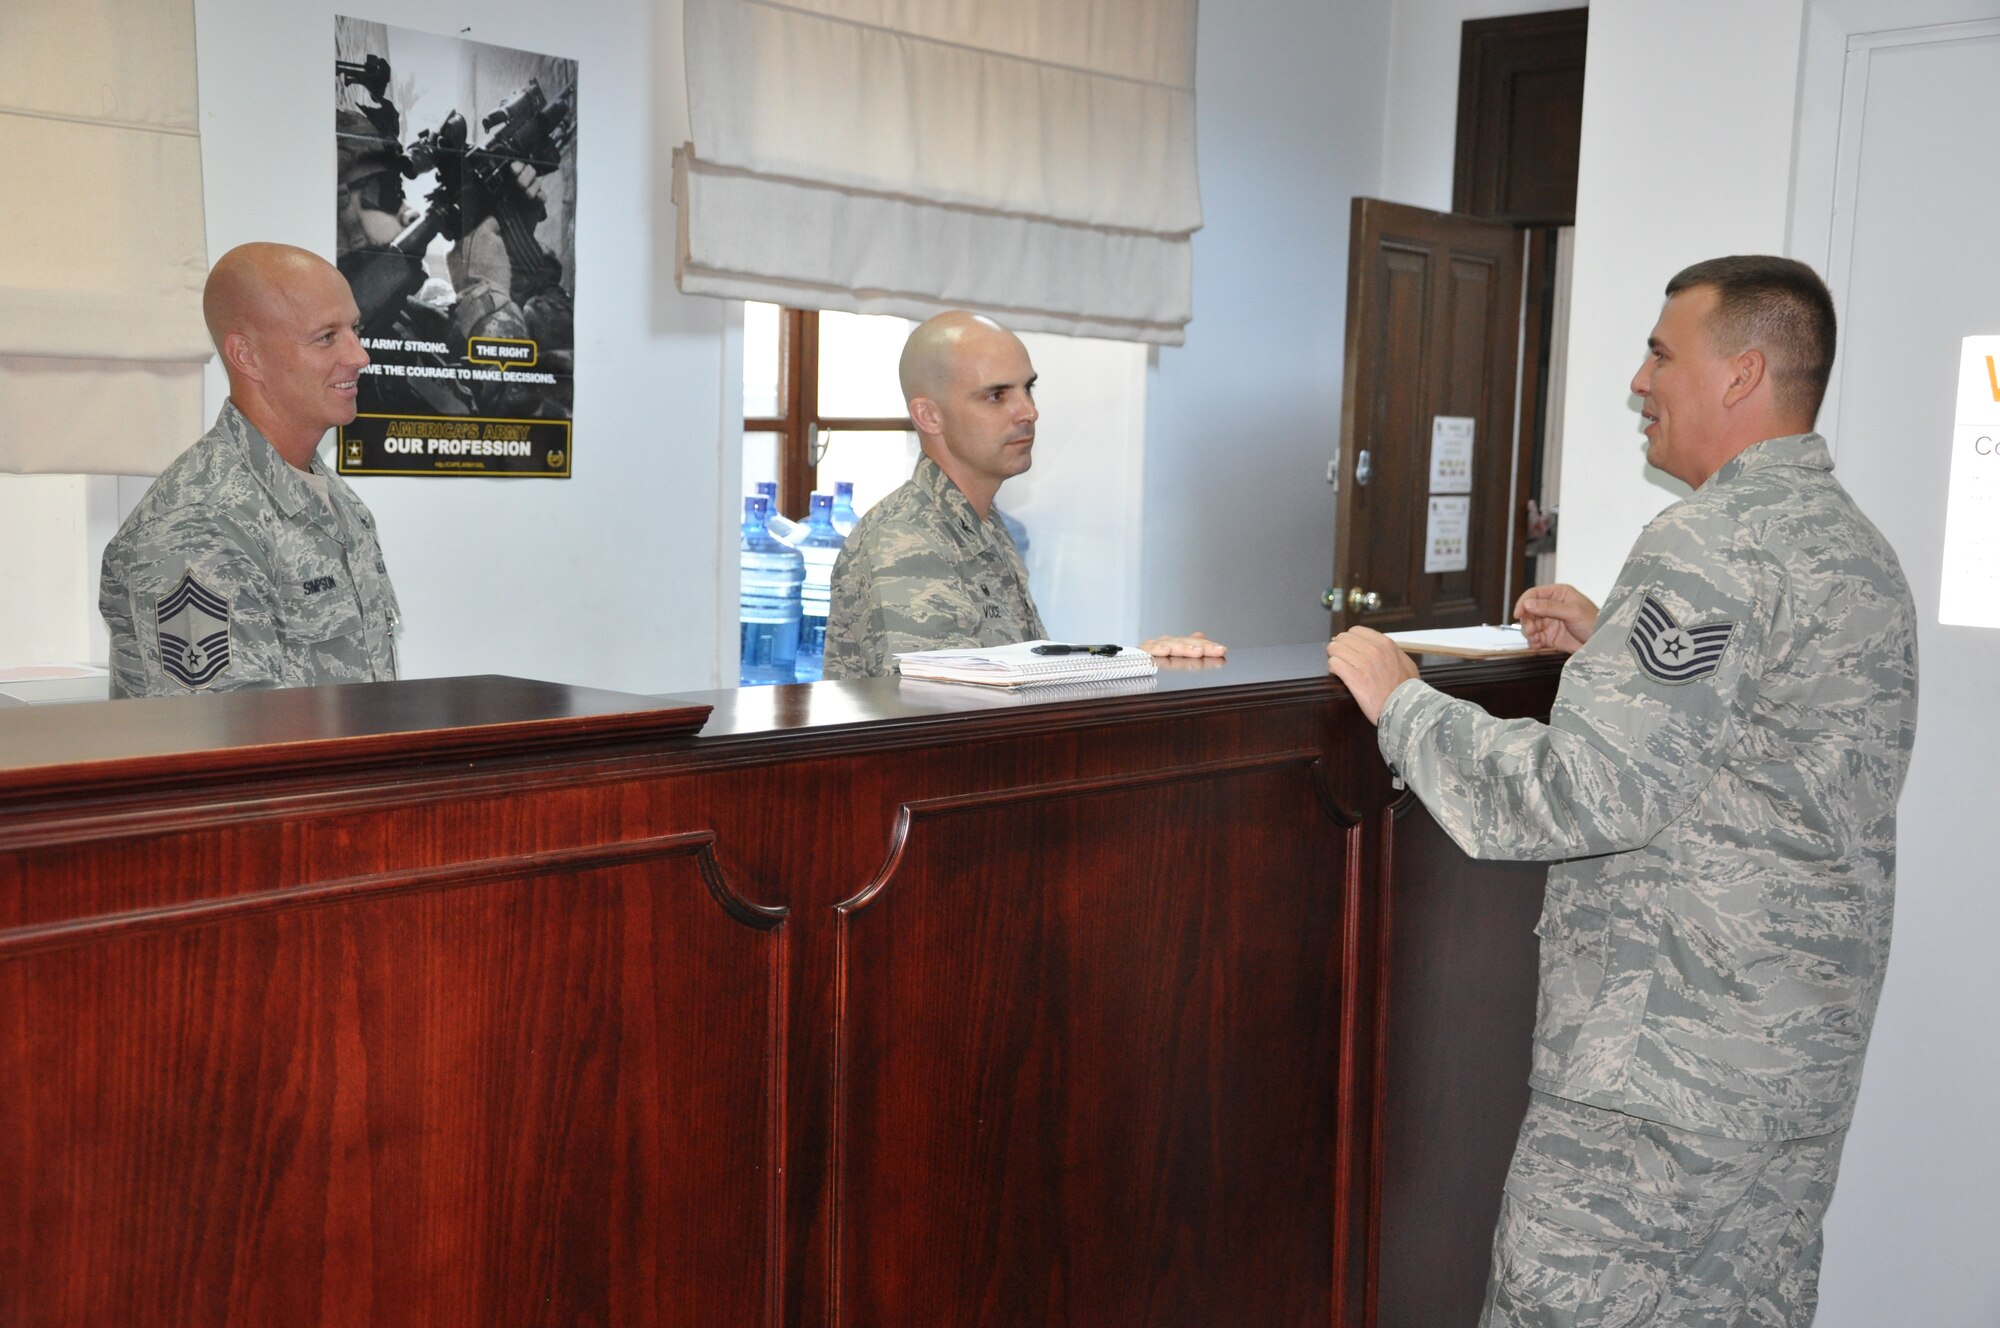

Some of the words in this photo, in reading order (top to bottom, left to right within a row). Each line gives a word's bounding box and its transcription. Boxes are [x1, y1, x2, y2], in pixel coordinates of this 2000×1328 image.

[360, 338, 370, 349] M
[371, 338, 403, 351] ARMY
[404, 340, 450, 354] STRONG.
[476, 345, 498, 357] THE
[498, 346, 530, 358] RIGHT
[359, 363, 382, 375] AVE
[383, 364, 405, 376] THE
[406, 366, 456, 379] COURAGE
[457, 369, 471, 380] TO
[472, 369, 502, 382] MAKE
[503, 371, 557, 384] DECISIONS.
[386, 421, 479, 439] AMERICA'S
[483, 424, 531, 441] ARMY
[384, 437, 424, 454] OUR
[428, 439, 531, 456] PROFESSION
[303, 575, 337, 595] SIMPSON
